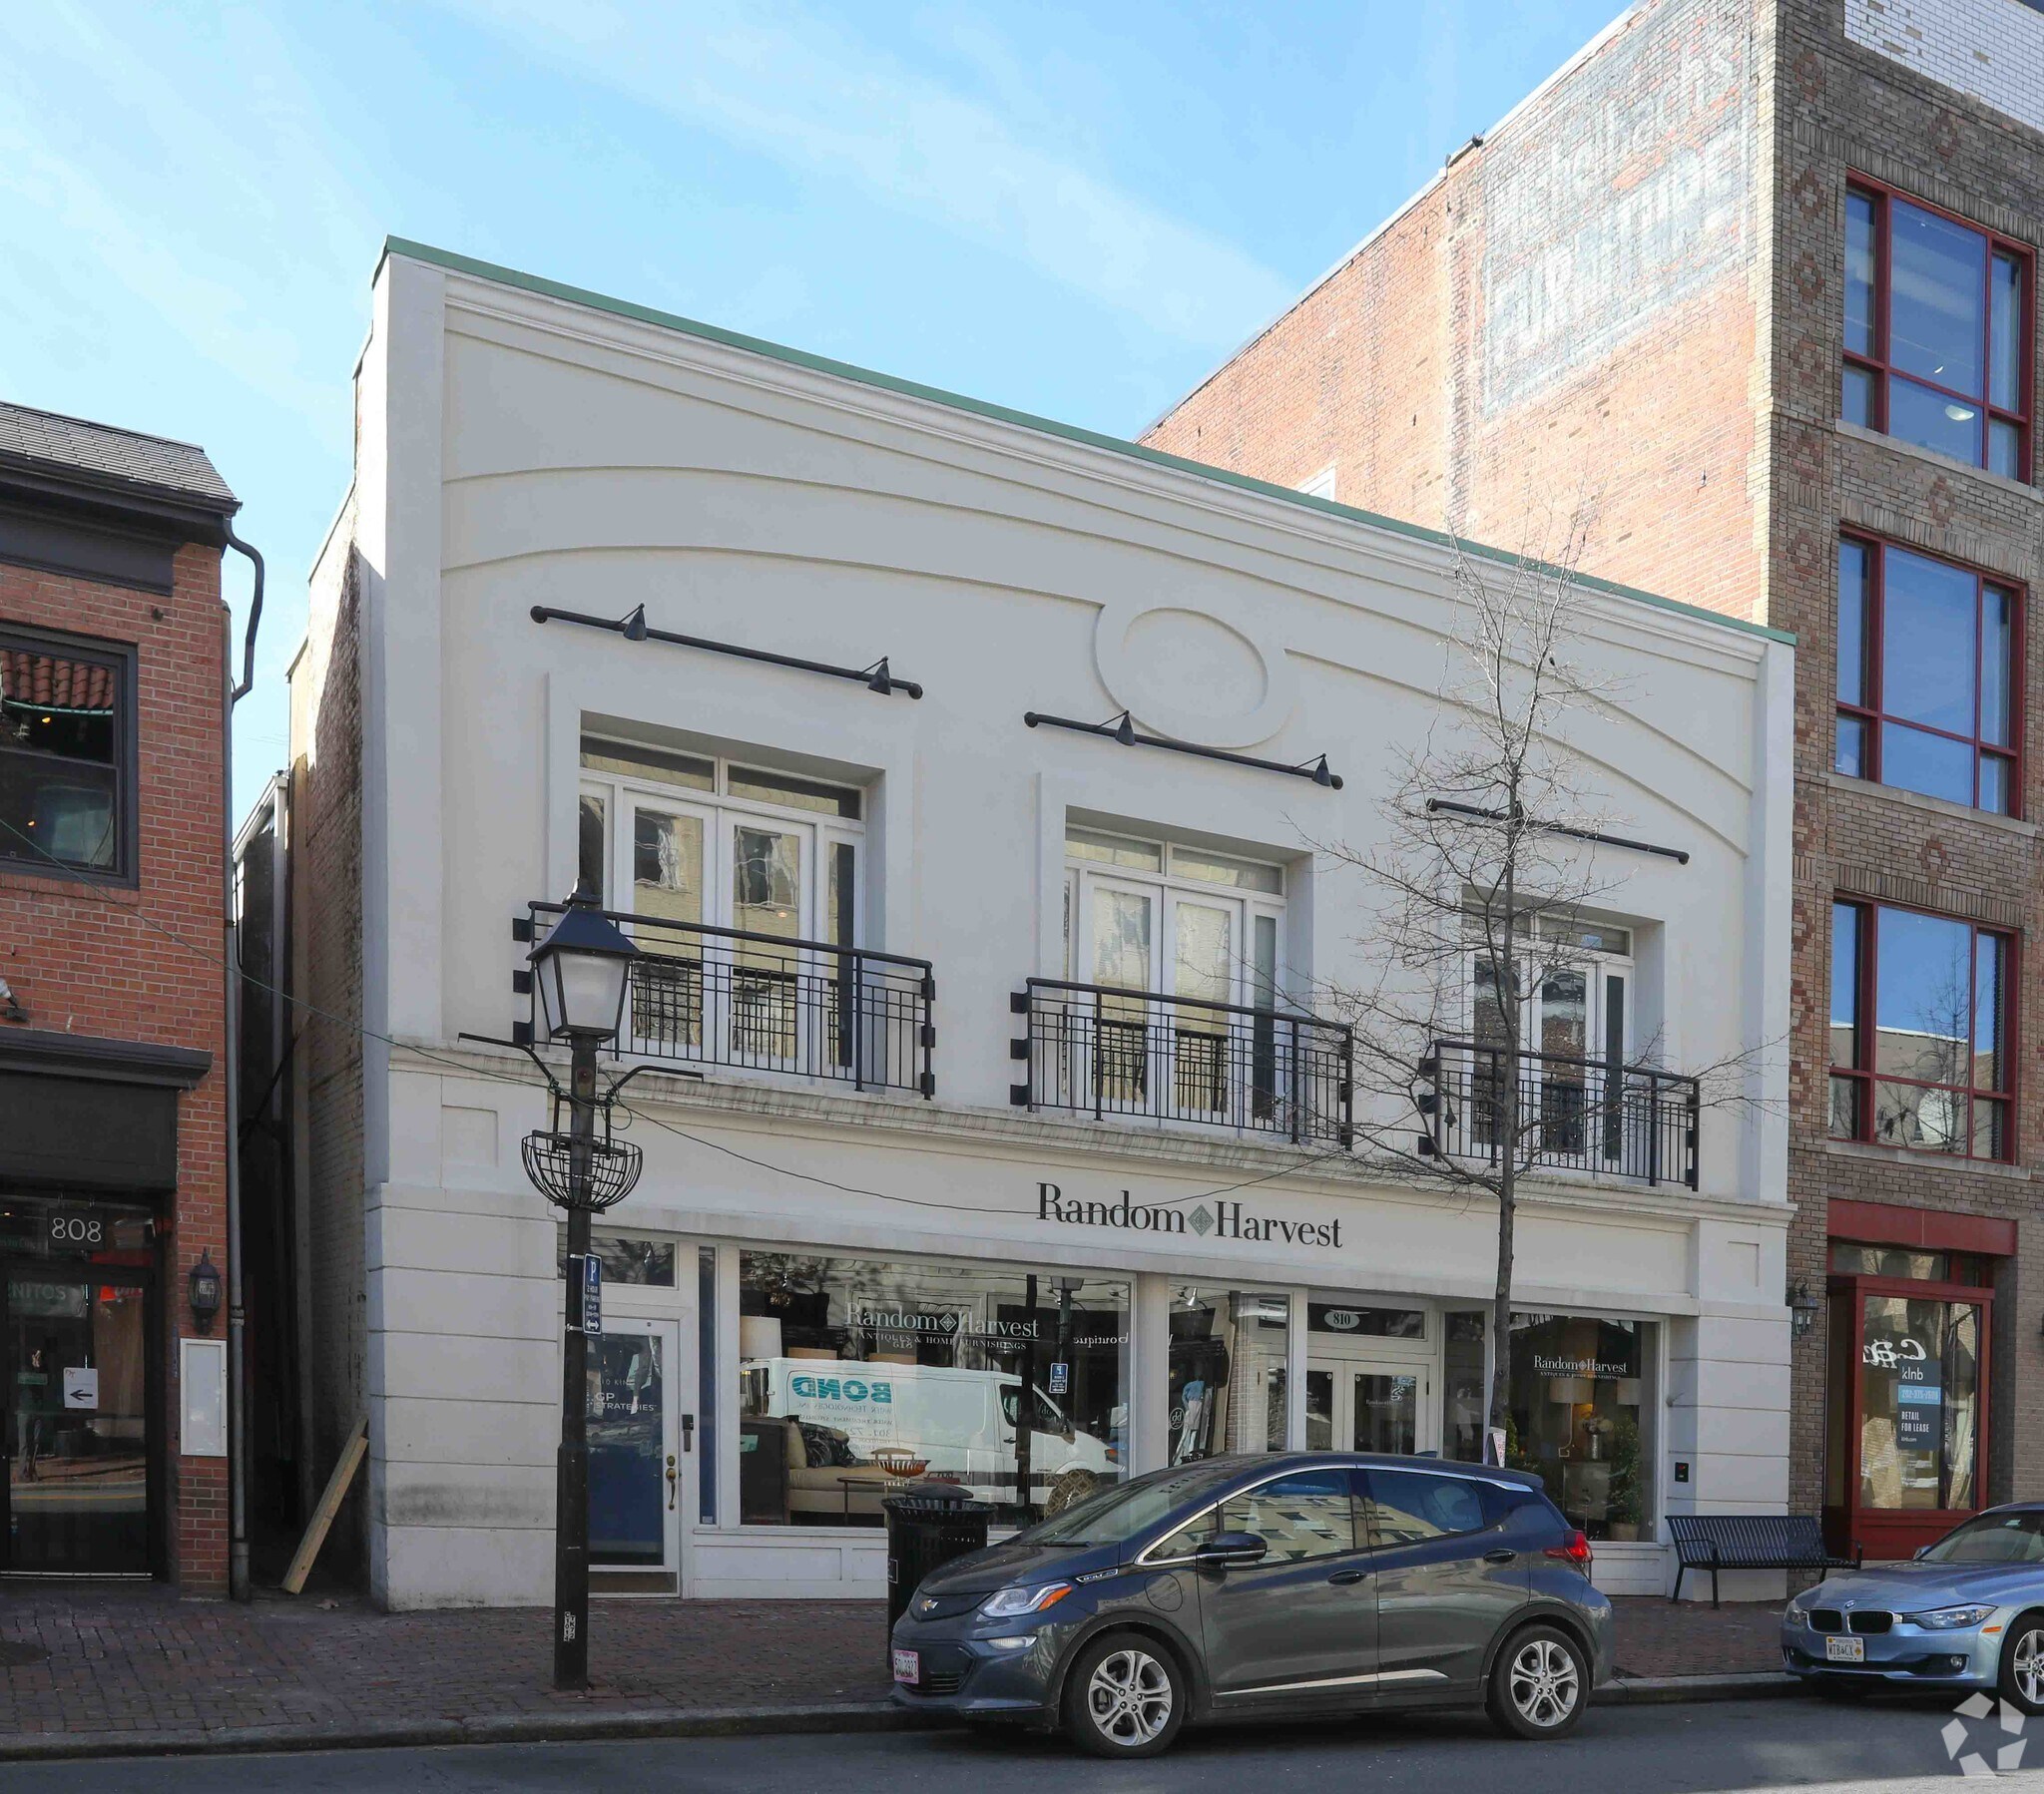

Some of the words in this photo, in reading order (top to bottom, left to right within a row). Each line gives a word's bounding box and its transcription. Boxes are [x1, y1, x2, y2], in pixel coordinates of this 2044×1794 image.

[1036, 1182, 1187, 1234] Random
[1214, 1200, 1343, 1249] Harvest
[51, 1217, 102, 1242] 808
[590, 1260, 596, 1282] P
[843, 1301, 940, 1331] Random
[957, 1310, 1040, 1339] Harvest
[1332, 1312, 1351, 1326] 810
[859, 1331, 912, 1343] ANTIQUES
[926, 1337, 955, 1346] HOME
[958, 1339, 1027, 1350] FURNISHINGS
[1533, 1354, 1578, 1370] Random
[1586, 1358, 1628, 1374] Harvest
[1901, 1366, 1924, 1381] klnb
[595, 1392, 615, 1402] GP
[595, 1401, 655, 1412] STRATEGIES
[1901, 1411, 1919, 1421] RETAIL
[1901, 1423, 1911, 1432] FOR
[1913, 1424, 1929, 1433] LEASE
